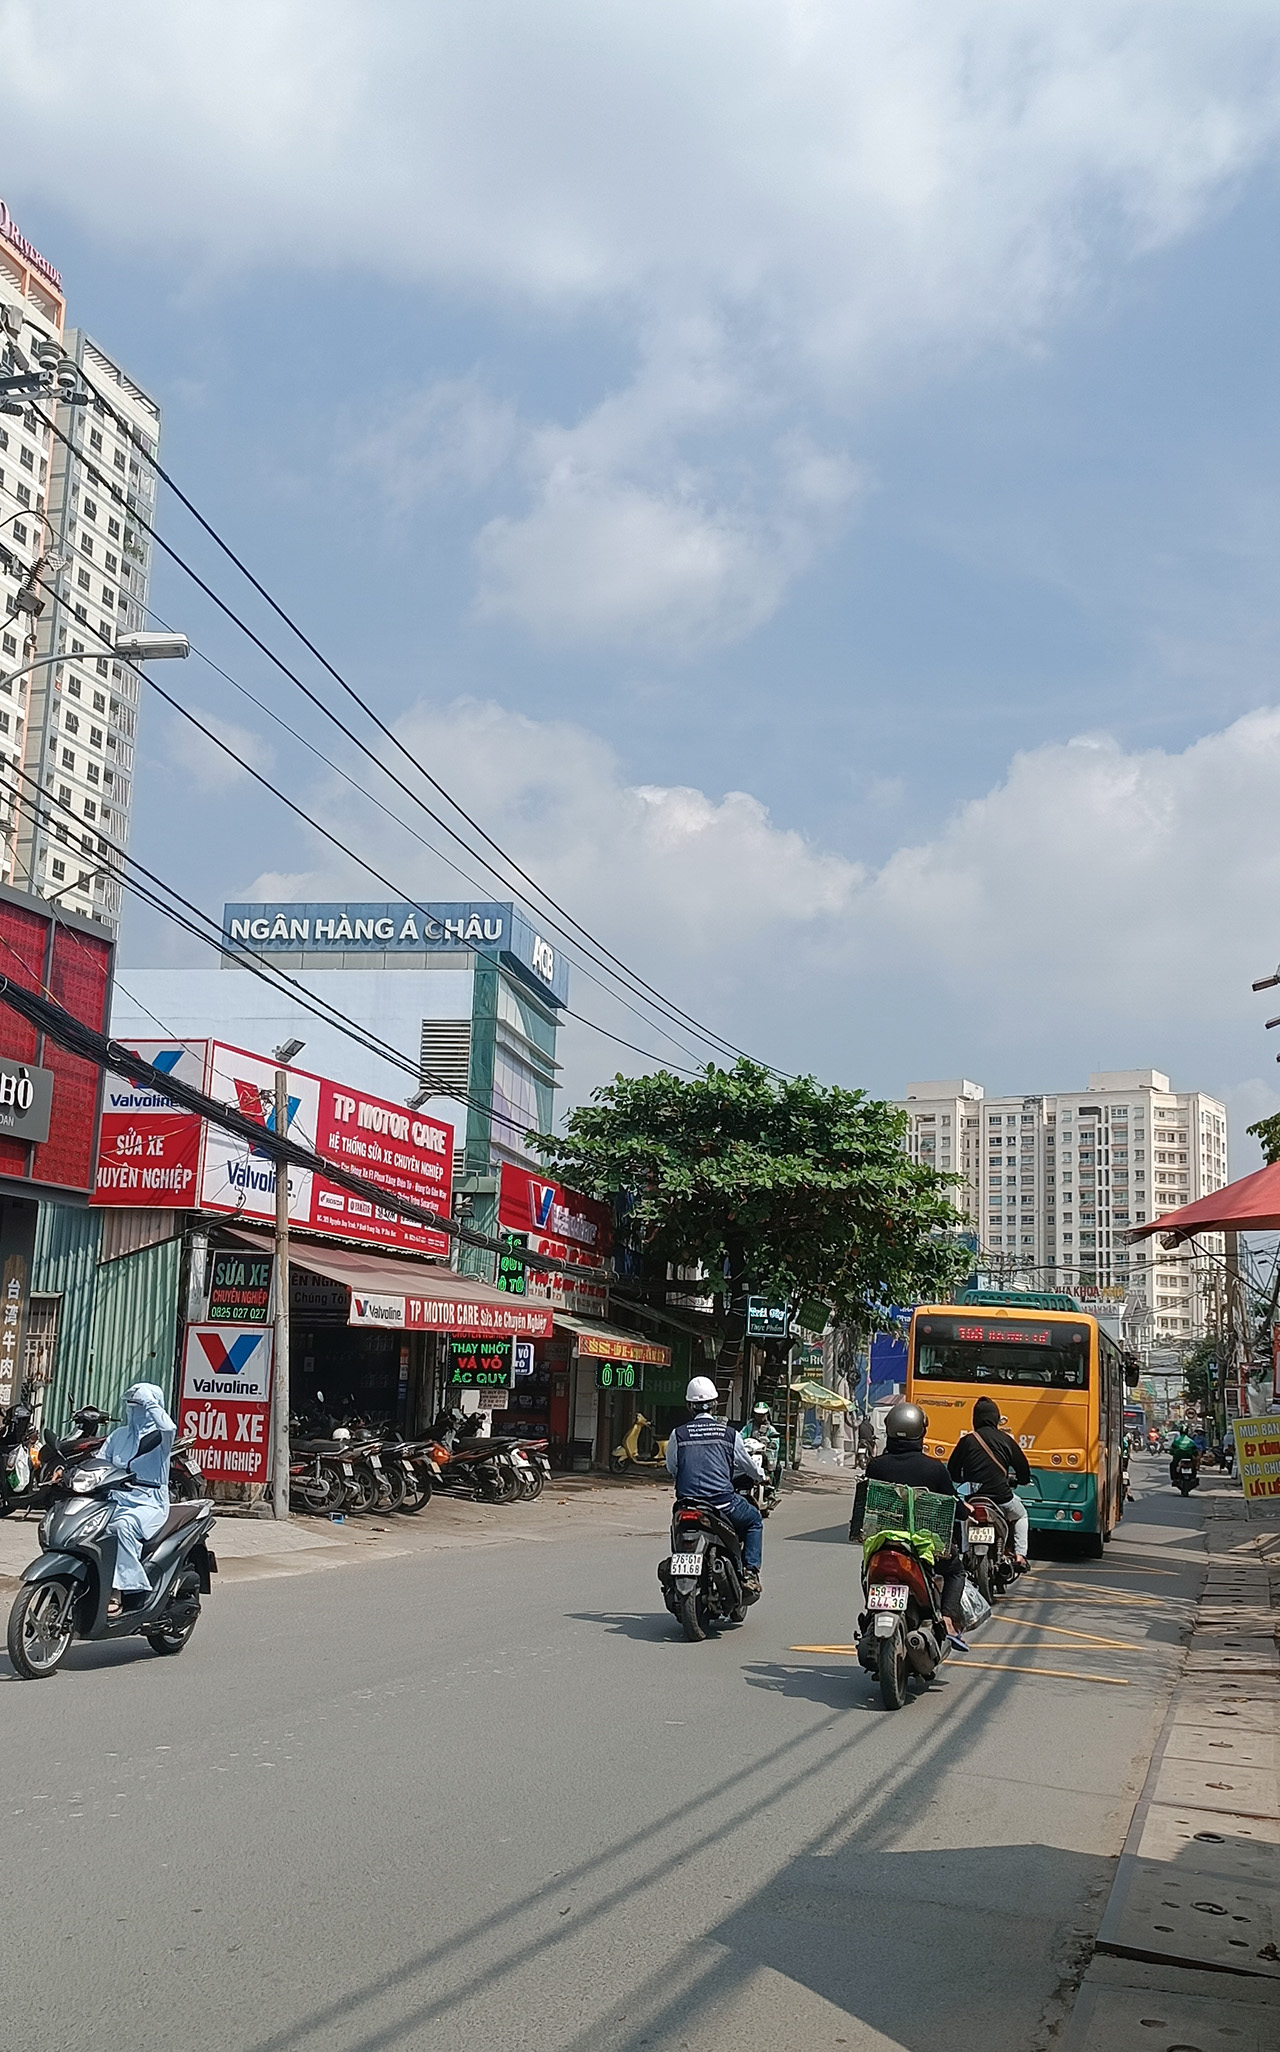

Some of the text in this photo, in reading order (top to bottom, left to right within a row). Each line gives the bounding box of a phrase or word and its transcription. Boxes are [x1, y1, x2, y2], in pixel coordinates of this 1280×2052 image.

[230, 913, 503, 940] NGÂN HÀNG Á CHÂU
[532, 935, 555, 982] ACB
[0, 1067, 34, 1109] BÒ
[333, 1093, 447, 1155] TP MOTOR CARE
[116, 1128, 165, 1156] SỬA XE
[328, 1133, 444, 1183] HỆ THỐNG SỬA XE CHUYÊN NGHIỆP
[142, 1163, 192, 1194] NGHIỆP
[227, 1160, 293, 1199] Valvolie
[216, 1256, 269, 1286] SỬA XE
[498, 1275, 507, 1292] Ô
[509, 1276, 524, 1293] TÔ
[1072, 1286, 1099, 1298] KHOA
[212, 1288, 268, 1307] CHUYÊN NGHIỆP
[295, 1291, 328, 1306] Chúng
[211, 1306, 266, 1320] 0825 027 027
[369, 1304, 402, 1320] Valvoline
[410, 1300, 422, 1322] TP
[424, 1301, 454, 1324] MOTOR
[457, 1303, 479, 1326] CARE
[493, 1310, 503, 1328] Xe
[503, 1311, 526, 1332] Chuyên
[451, 1342, 510, 1355] THAY NHỚT
[518, 1346, 529, 1359] VỎ
[458, 1355, 503, 1370] VÁ VỎ
[451, 1369, 508, 1385] ẮC QUY
[602, 1363, 635, 1387] Ô TÔ
[193, 1378, 258, 1395] Valvoline
[184, 1402, 264, 1443] SỬA XE
[1239, 1421, 1280, 1438] MUA BÁN
[1244, 1440, 1257, 1457] ÉP
[186, 1444, 222, 1471] HUYÊN
[223, 1448, 262, 1477] NGHIỆP
[1249, 1478, 1267, 1496] LẤY
[672, 1564, 700, 1574] 511.68
[870, 1597, 904, 1609] 644.36
